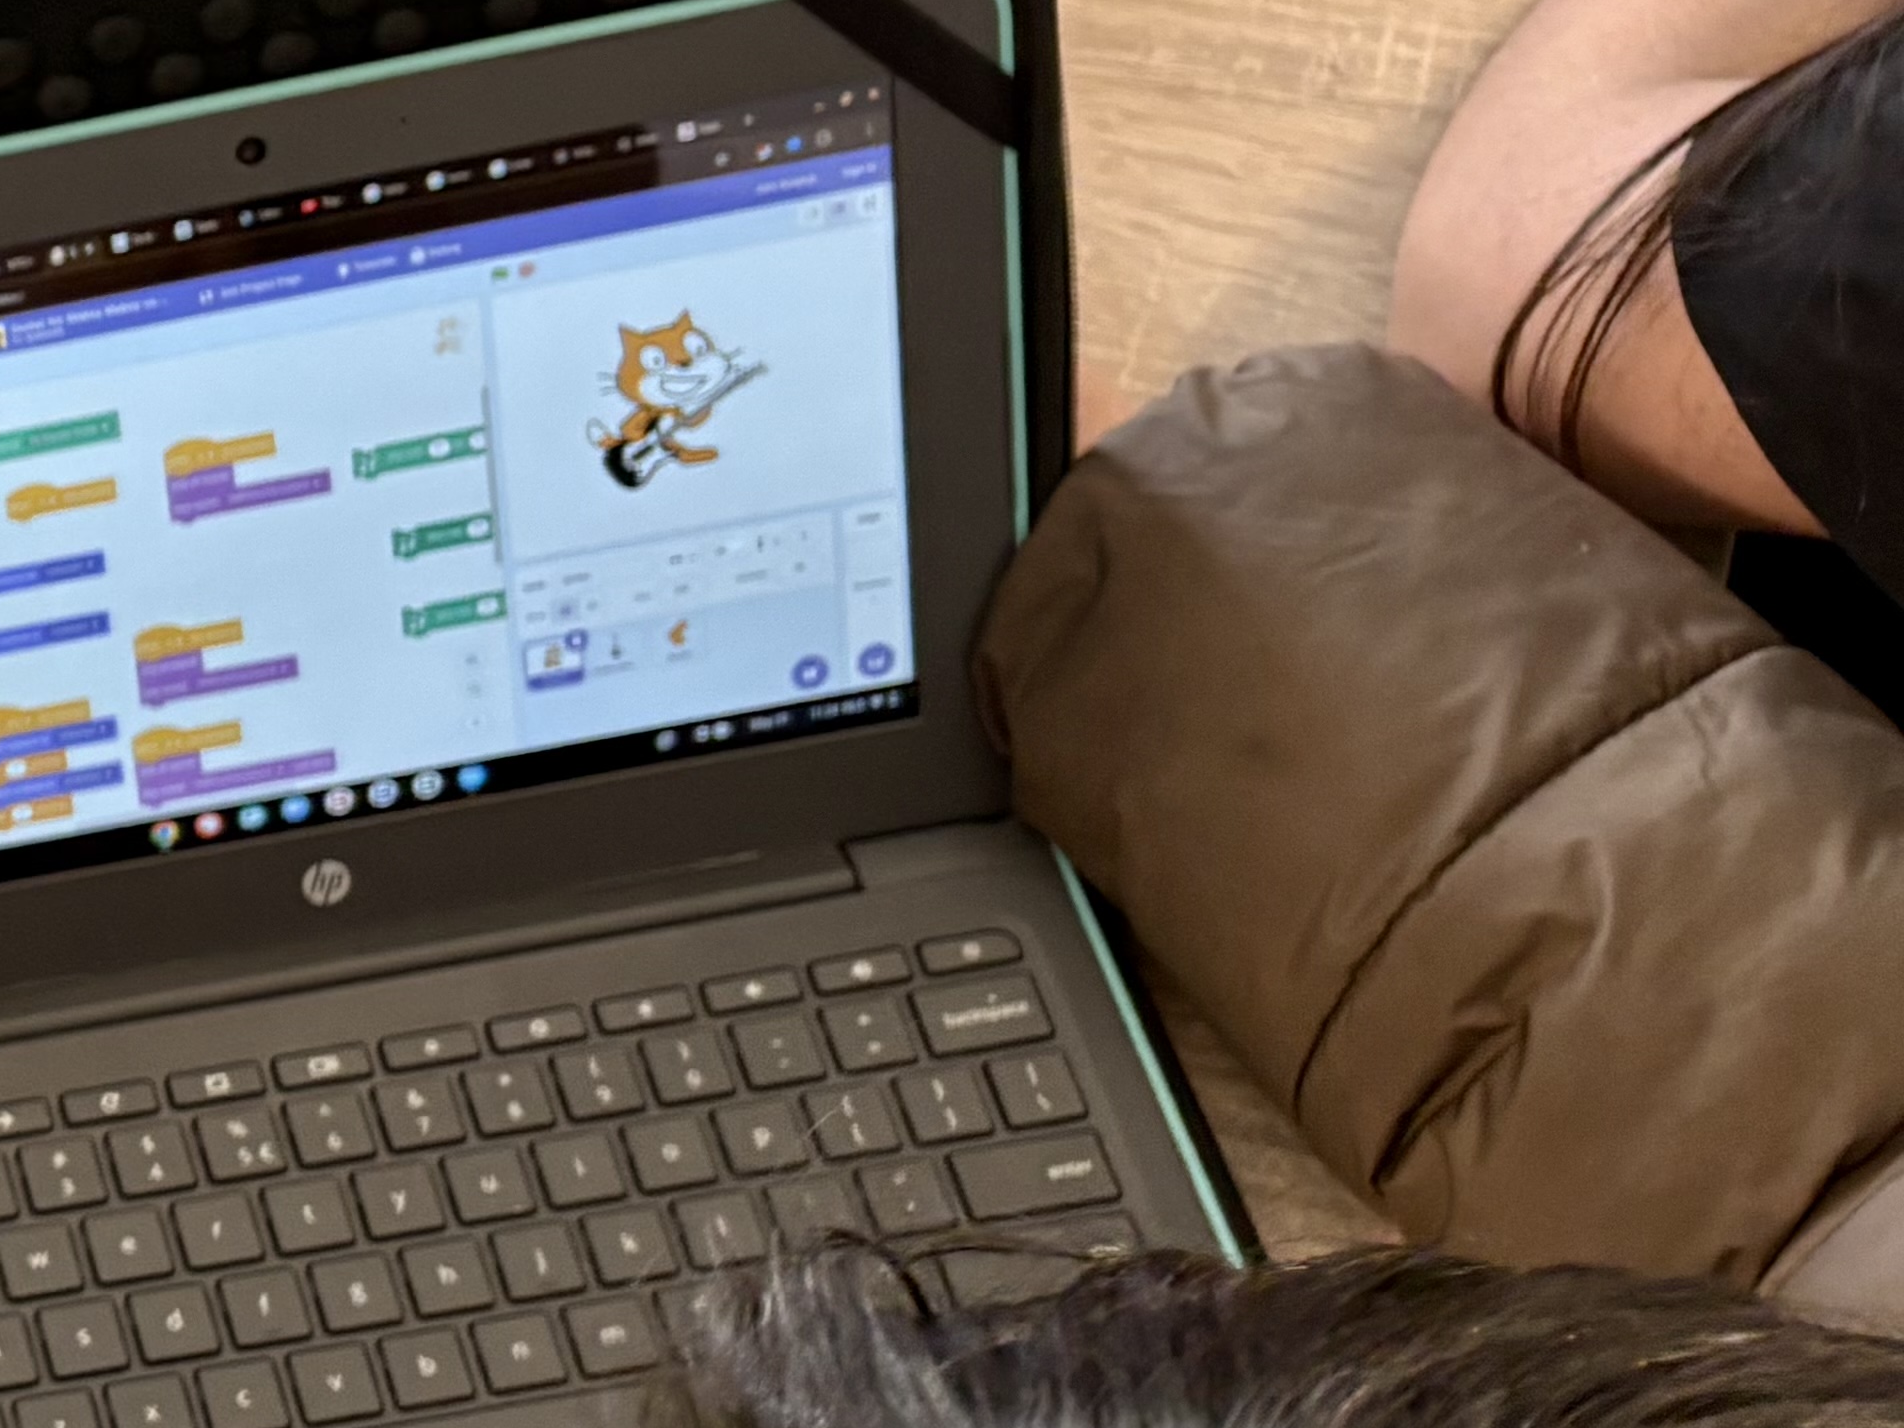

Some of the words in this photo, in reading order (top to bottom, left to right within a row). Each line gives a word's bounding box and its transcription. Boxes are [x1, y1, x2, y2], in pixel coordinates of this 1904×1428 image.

[306, 859, 347, 907] hp
[416, 1115, 431, 1136] 7
[26, 1250, 50, 1270] w
[235, 1388, 252, 1409] c
